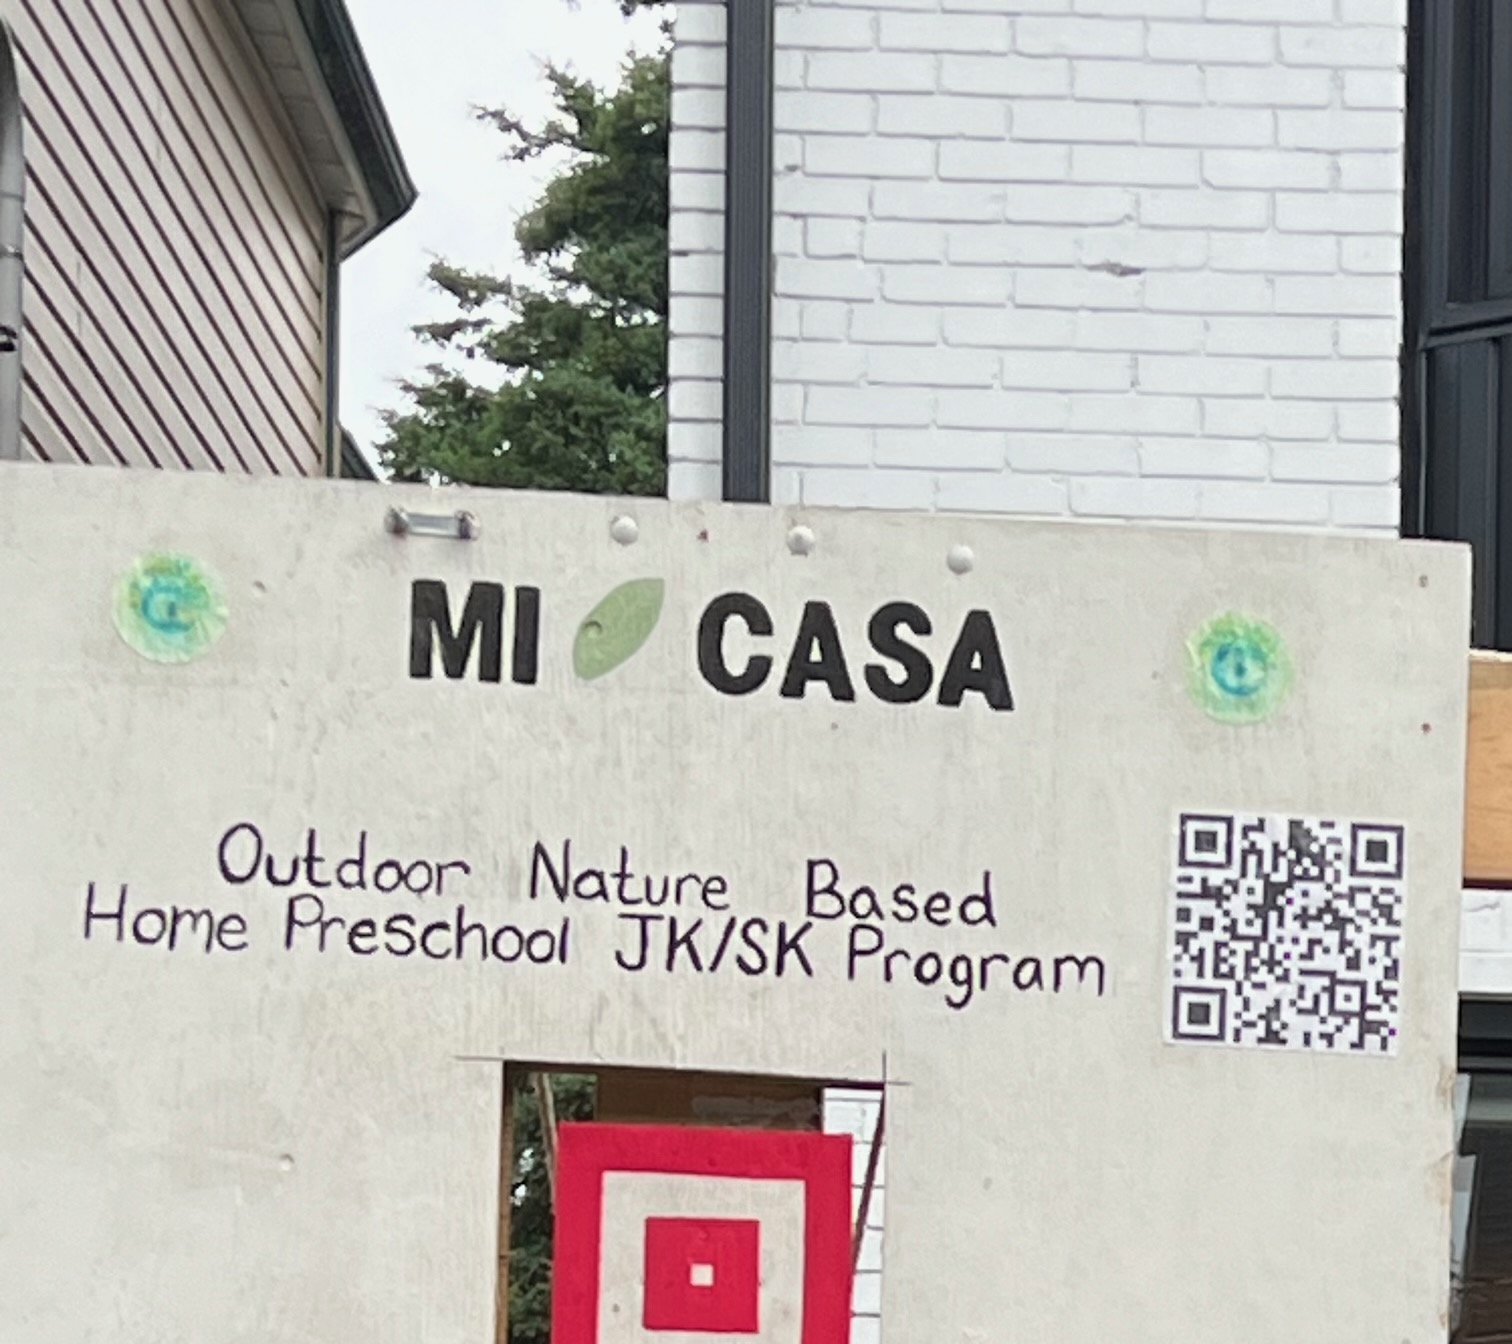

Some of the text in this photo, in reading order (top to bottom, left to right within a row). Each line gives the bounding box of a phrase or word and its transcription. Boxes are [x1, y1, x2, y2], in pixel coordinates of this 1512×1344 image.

[410, 579, 1014, 712] MI CASA
[218, 822, 997, 928] Outdoor Nature Based
[84, 882, 1105, 1010] Home Preschool JK/SK Program
